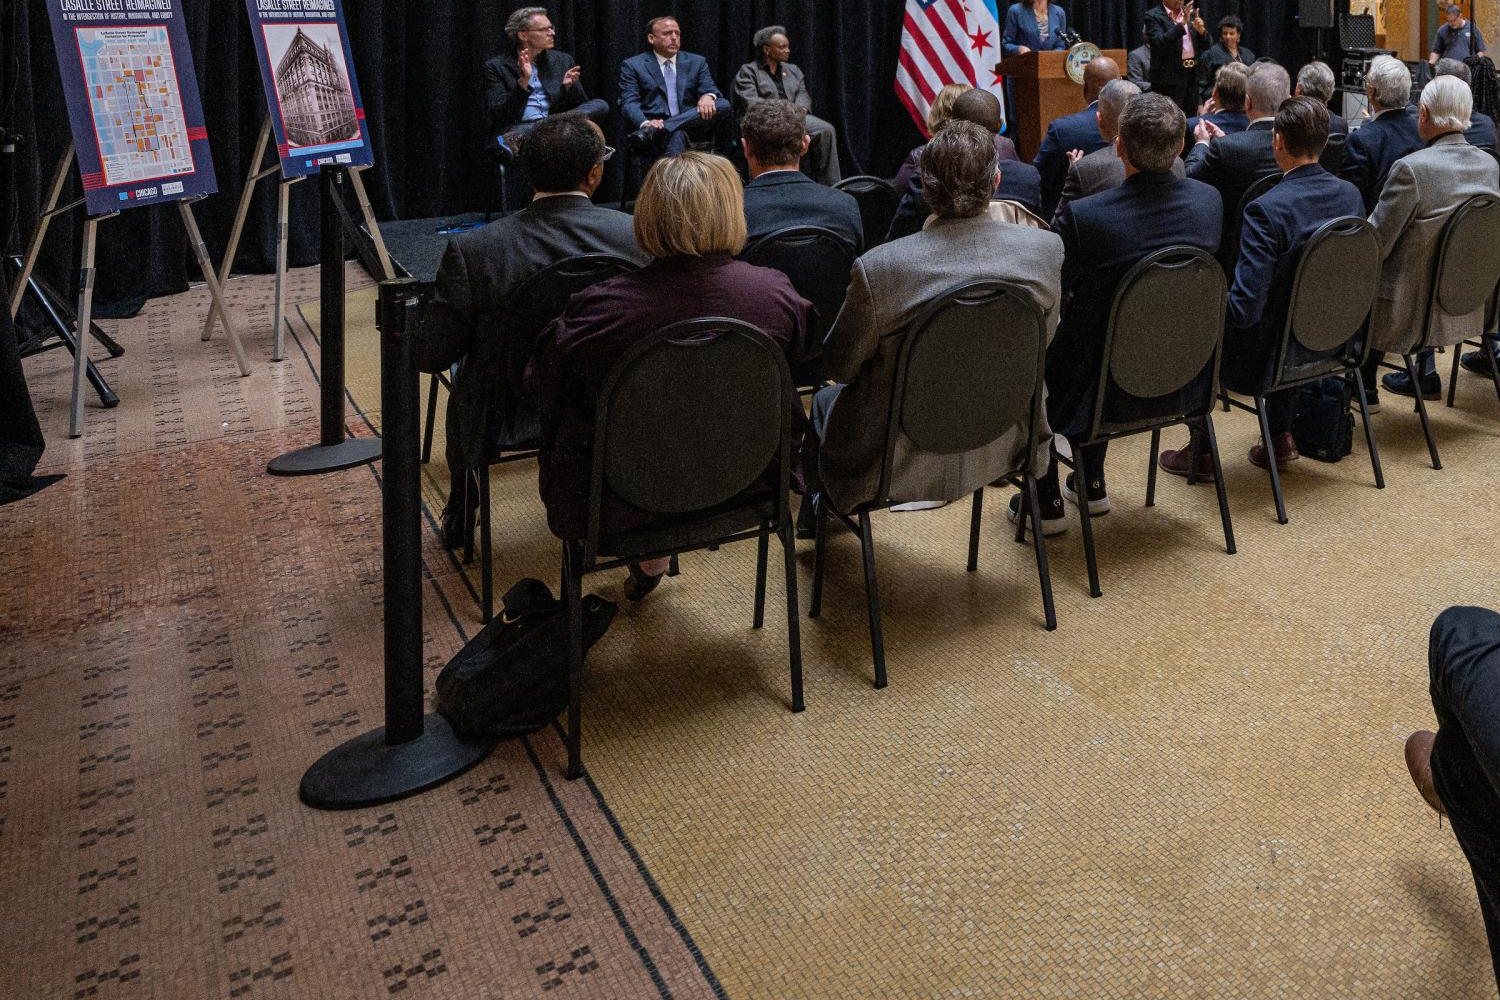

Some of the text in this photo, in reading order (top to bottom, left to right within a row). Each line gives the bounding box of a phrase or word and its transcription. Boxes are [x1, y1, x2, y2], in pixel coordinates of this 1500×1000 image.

[256, 0, 281, 10] LASALLE
[282, 0, 301, 10] STREET
[135, 187, 157, 198] CHICAGO
